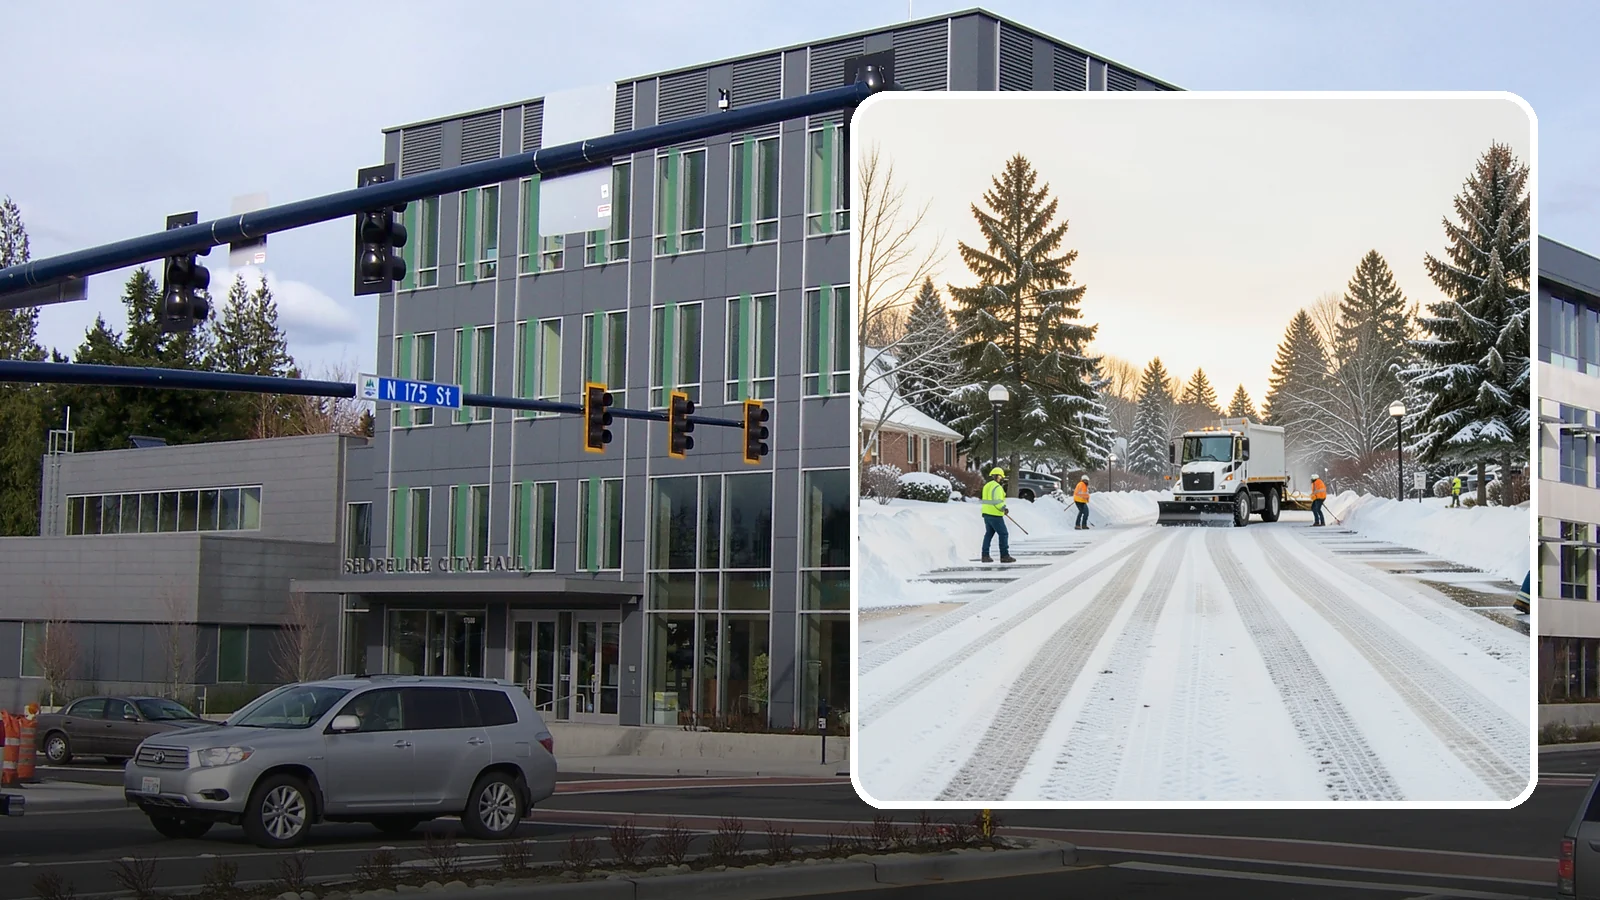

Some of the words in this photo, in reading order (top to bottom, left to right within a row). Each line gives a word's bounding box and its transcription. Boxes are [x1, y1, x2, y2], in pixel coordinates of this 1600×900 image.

[387, 380, 396, 399] N
[405, 382, 428, 403] 175
[436, 386, 451, 406] St
[344, 557, 432, 574] SHORELINE
[438, 556, 475, 572] CITY
[483, 555, 525, 571] HALL
